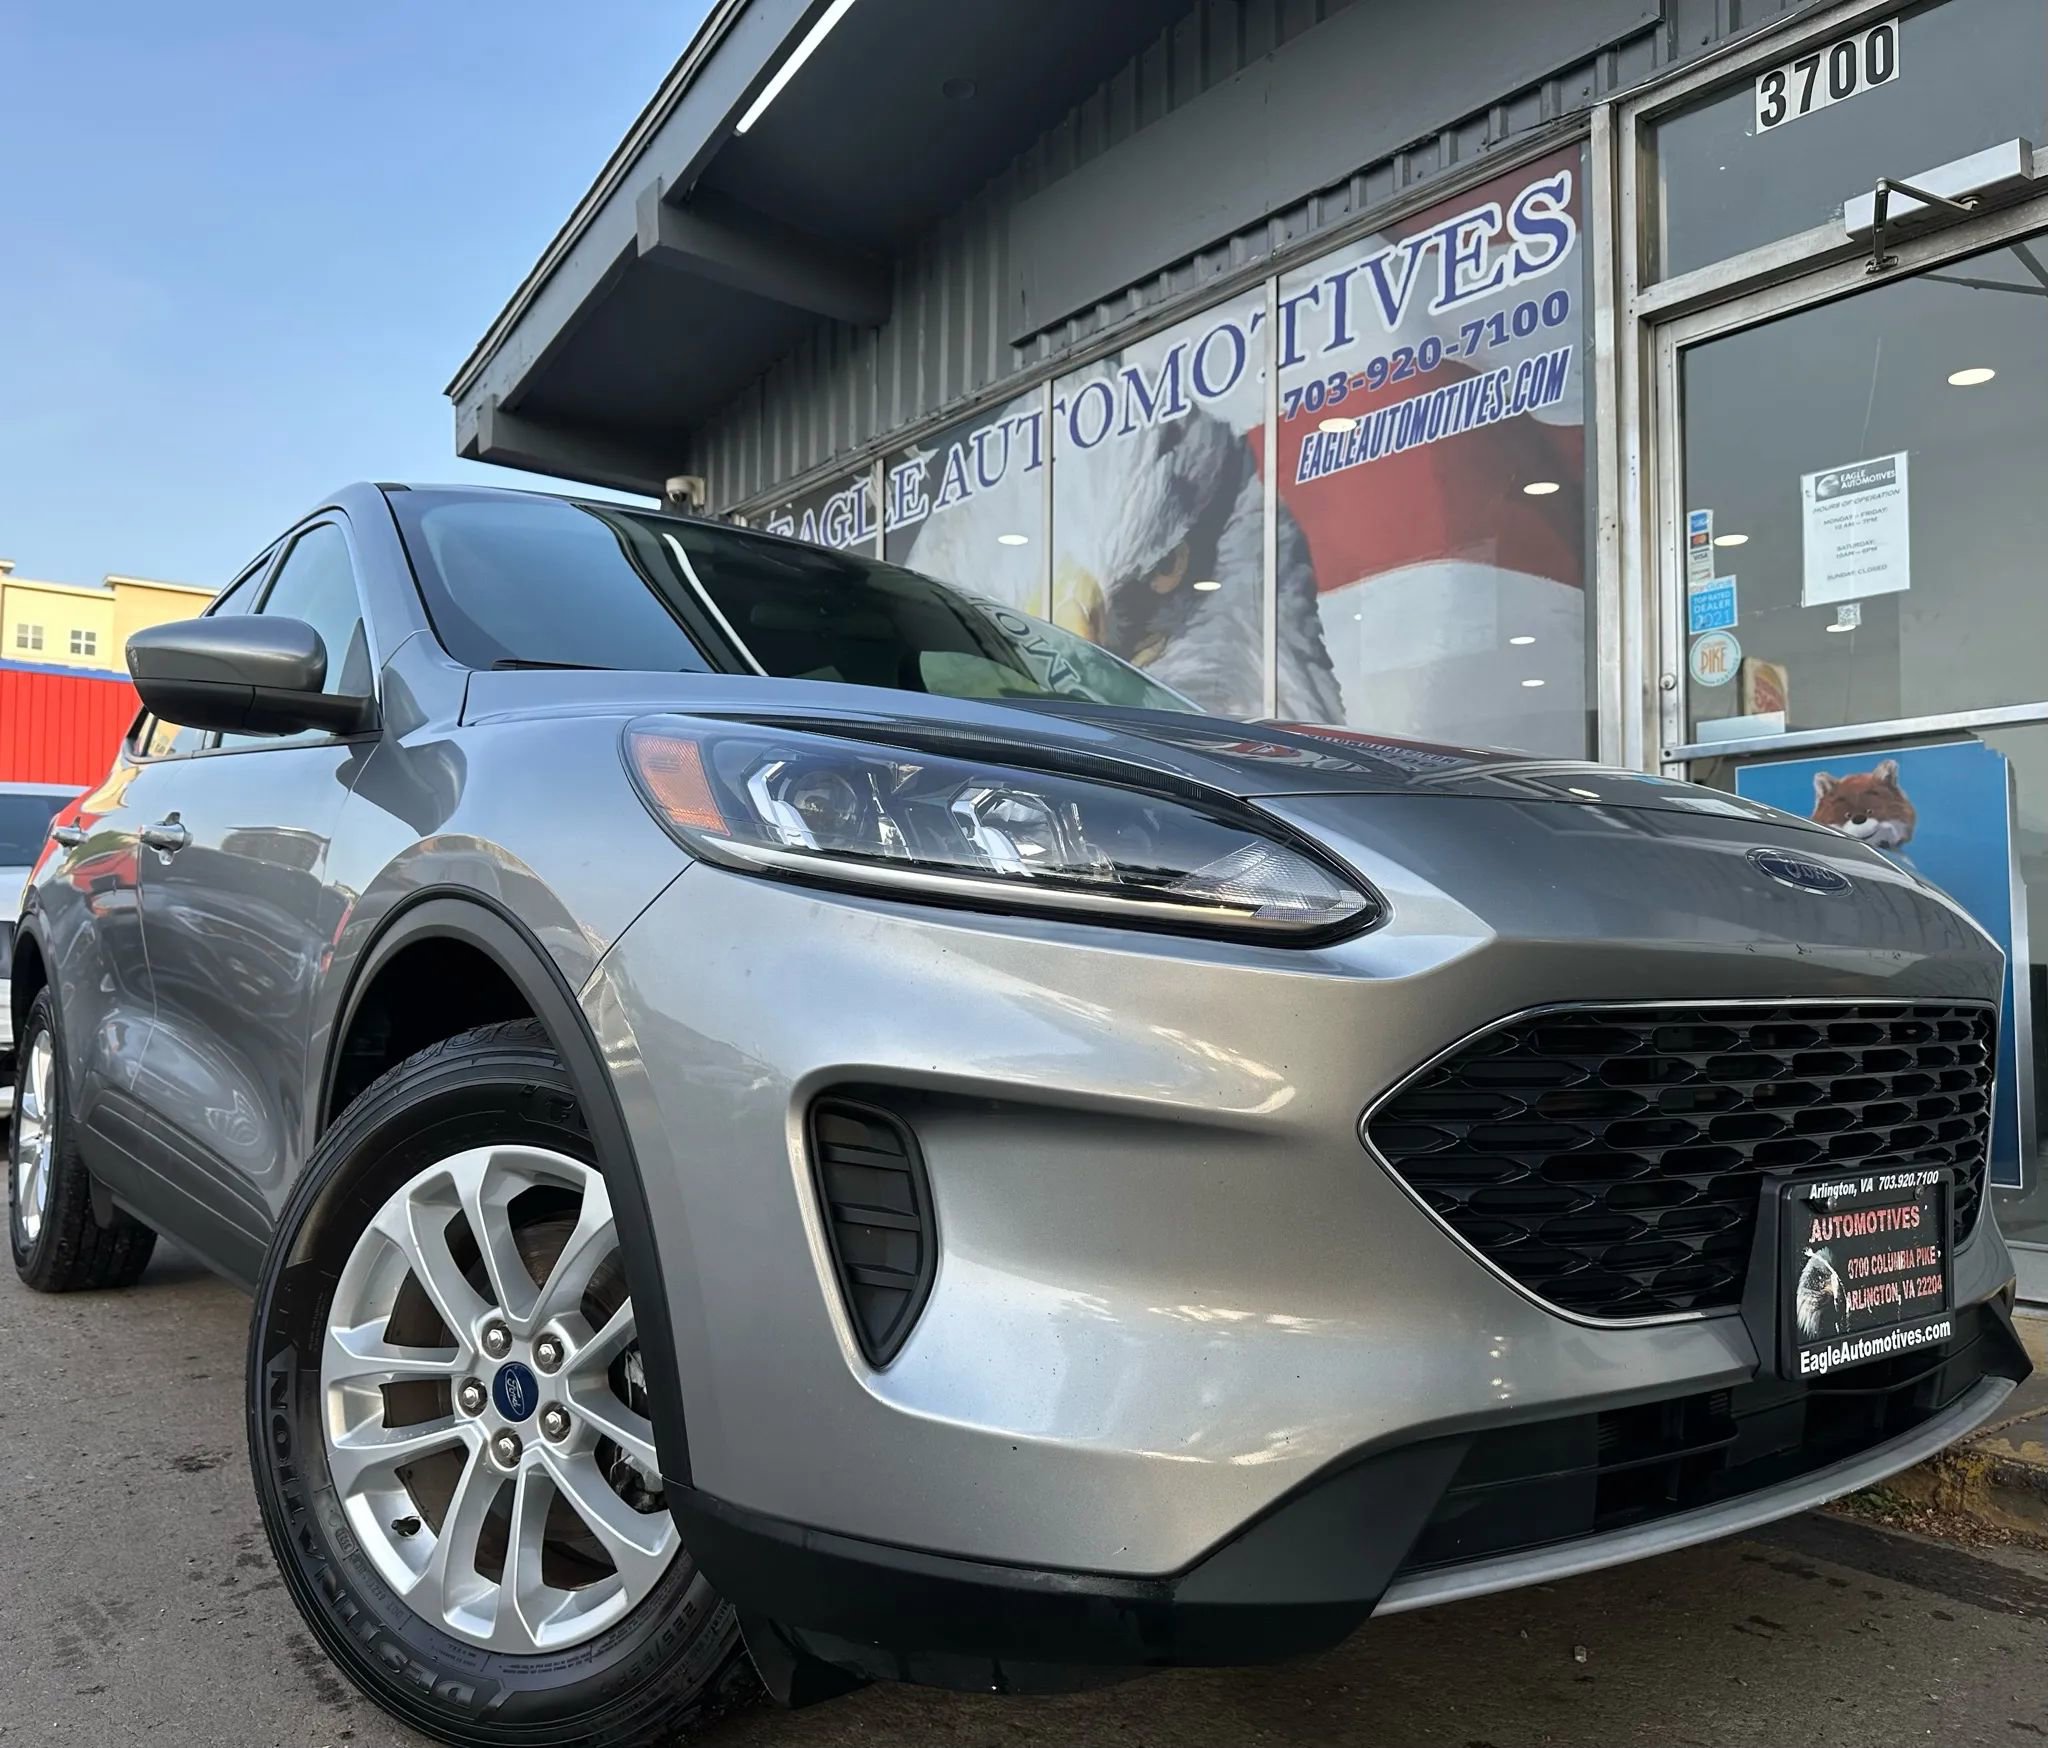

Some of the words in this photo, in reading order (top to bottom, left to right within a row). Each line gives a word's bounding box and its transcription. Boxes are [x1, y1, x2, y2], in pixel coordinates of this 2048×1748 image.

[1760, 25, 1894, 128] 3700
[933, 168, 1577, 510] AUTOMOTIVES
[1284, 288, 1571, 422] 703-920-7100
[1295, 344, 1574, 485] EAGLEAUTOMOTIVES.COM
[1840, 469, 1866, 482] EAGLE
[1841, 470, 1896, 489] AUTOMOTIVES
[1693, 552, 1708, 561] VISA
[1694, 599, 1731, 614] DEALER
[1694, 610, 1732, 629] 2021
[1700, 647, 1727, 674] PIKE
[1809, 1181, 1857, 1200] Arlington,
[1860, 1177, 1873, 1193] VA
[1878, 1170, 1940, 1190] 703.920.7100
[1808, 1205, 1920, 1243] AUTOMOTIVES
[1870, 1248, 1915, 1275] COLUMBIA
[1916, 1245, 1936, 1267] PIKE
[1902, 1279, 1915, 1300] VA
[1800, 1320, 1951, 1375] EagleAutomotives.com
